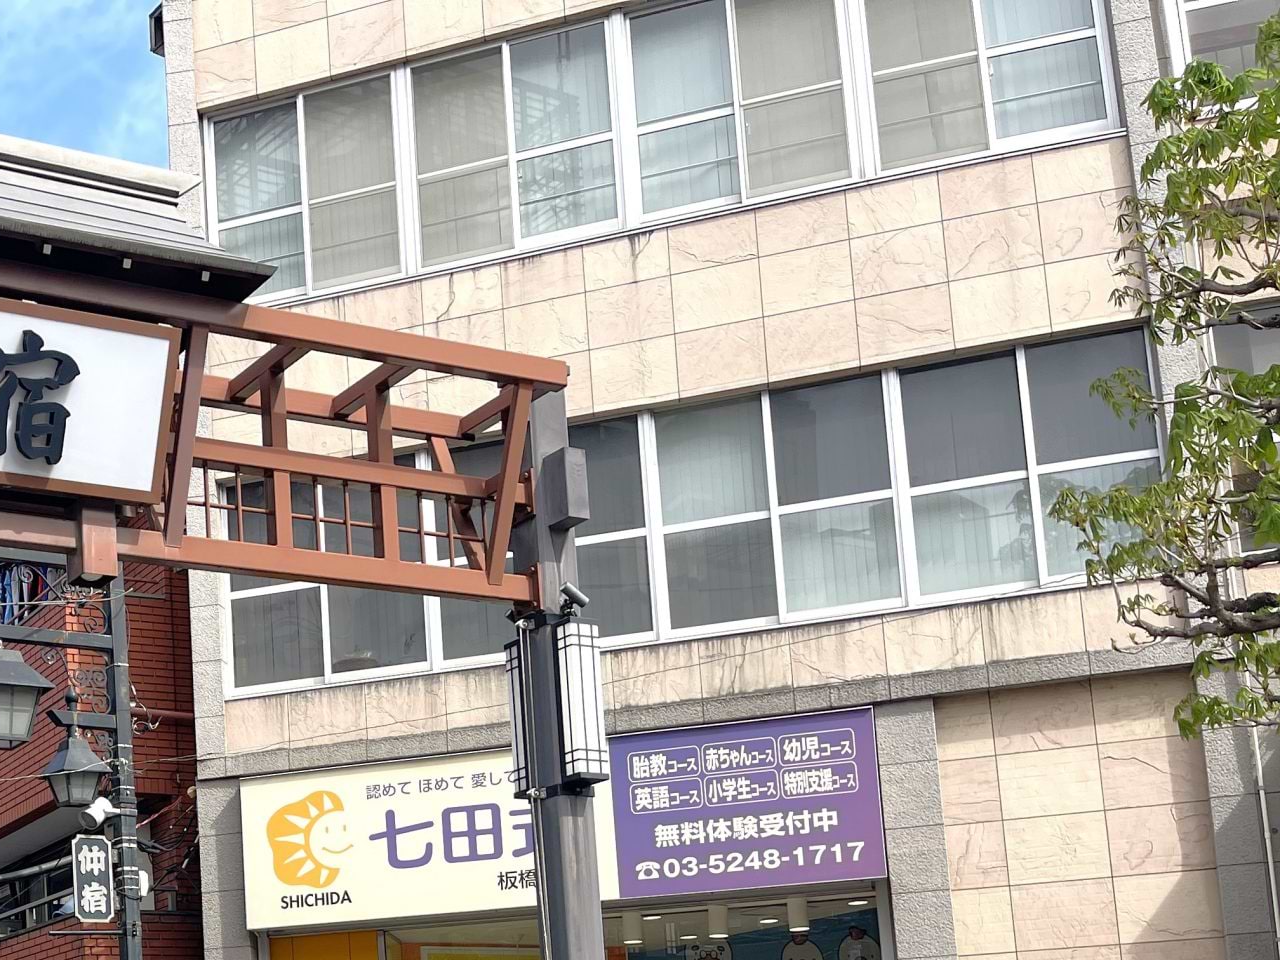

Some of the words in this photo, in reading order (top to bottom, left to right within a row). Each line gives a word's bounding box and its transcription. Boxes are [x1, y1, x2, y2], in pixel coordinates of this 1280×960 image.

[705, 745, 774, 771] 赤ちゃんコース
[783, 736, 852, 762] 幼児コース
[632, 752, 697, 779] 胎教コース
[366, 781, 411, 800] 認めて
[418, 775, 464, 793] ほめて
[471, 768, 520, 789] 愛して
[708, 777, 776, 803] 小学生コース
[784, 768, 855, 796] 特別支援コース
[635, 786, 700, 810] 英語コース
[654, 808, 838, 848] 無料体験受付中
[663, 841, 865, 879] 03-5248-1717
[78, 844, 108, 914] 仲宿
[497, 869, 537, 891] 板橋
[280, 890, 352, 909] SHICHIDA
